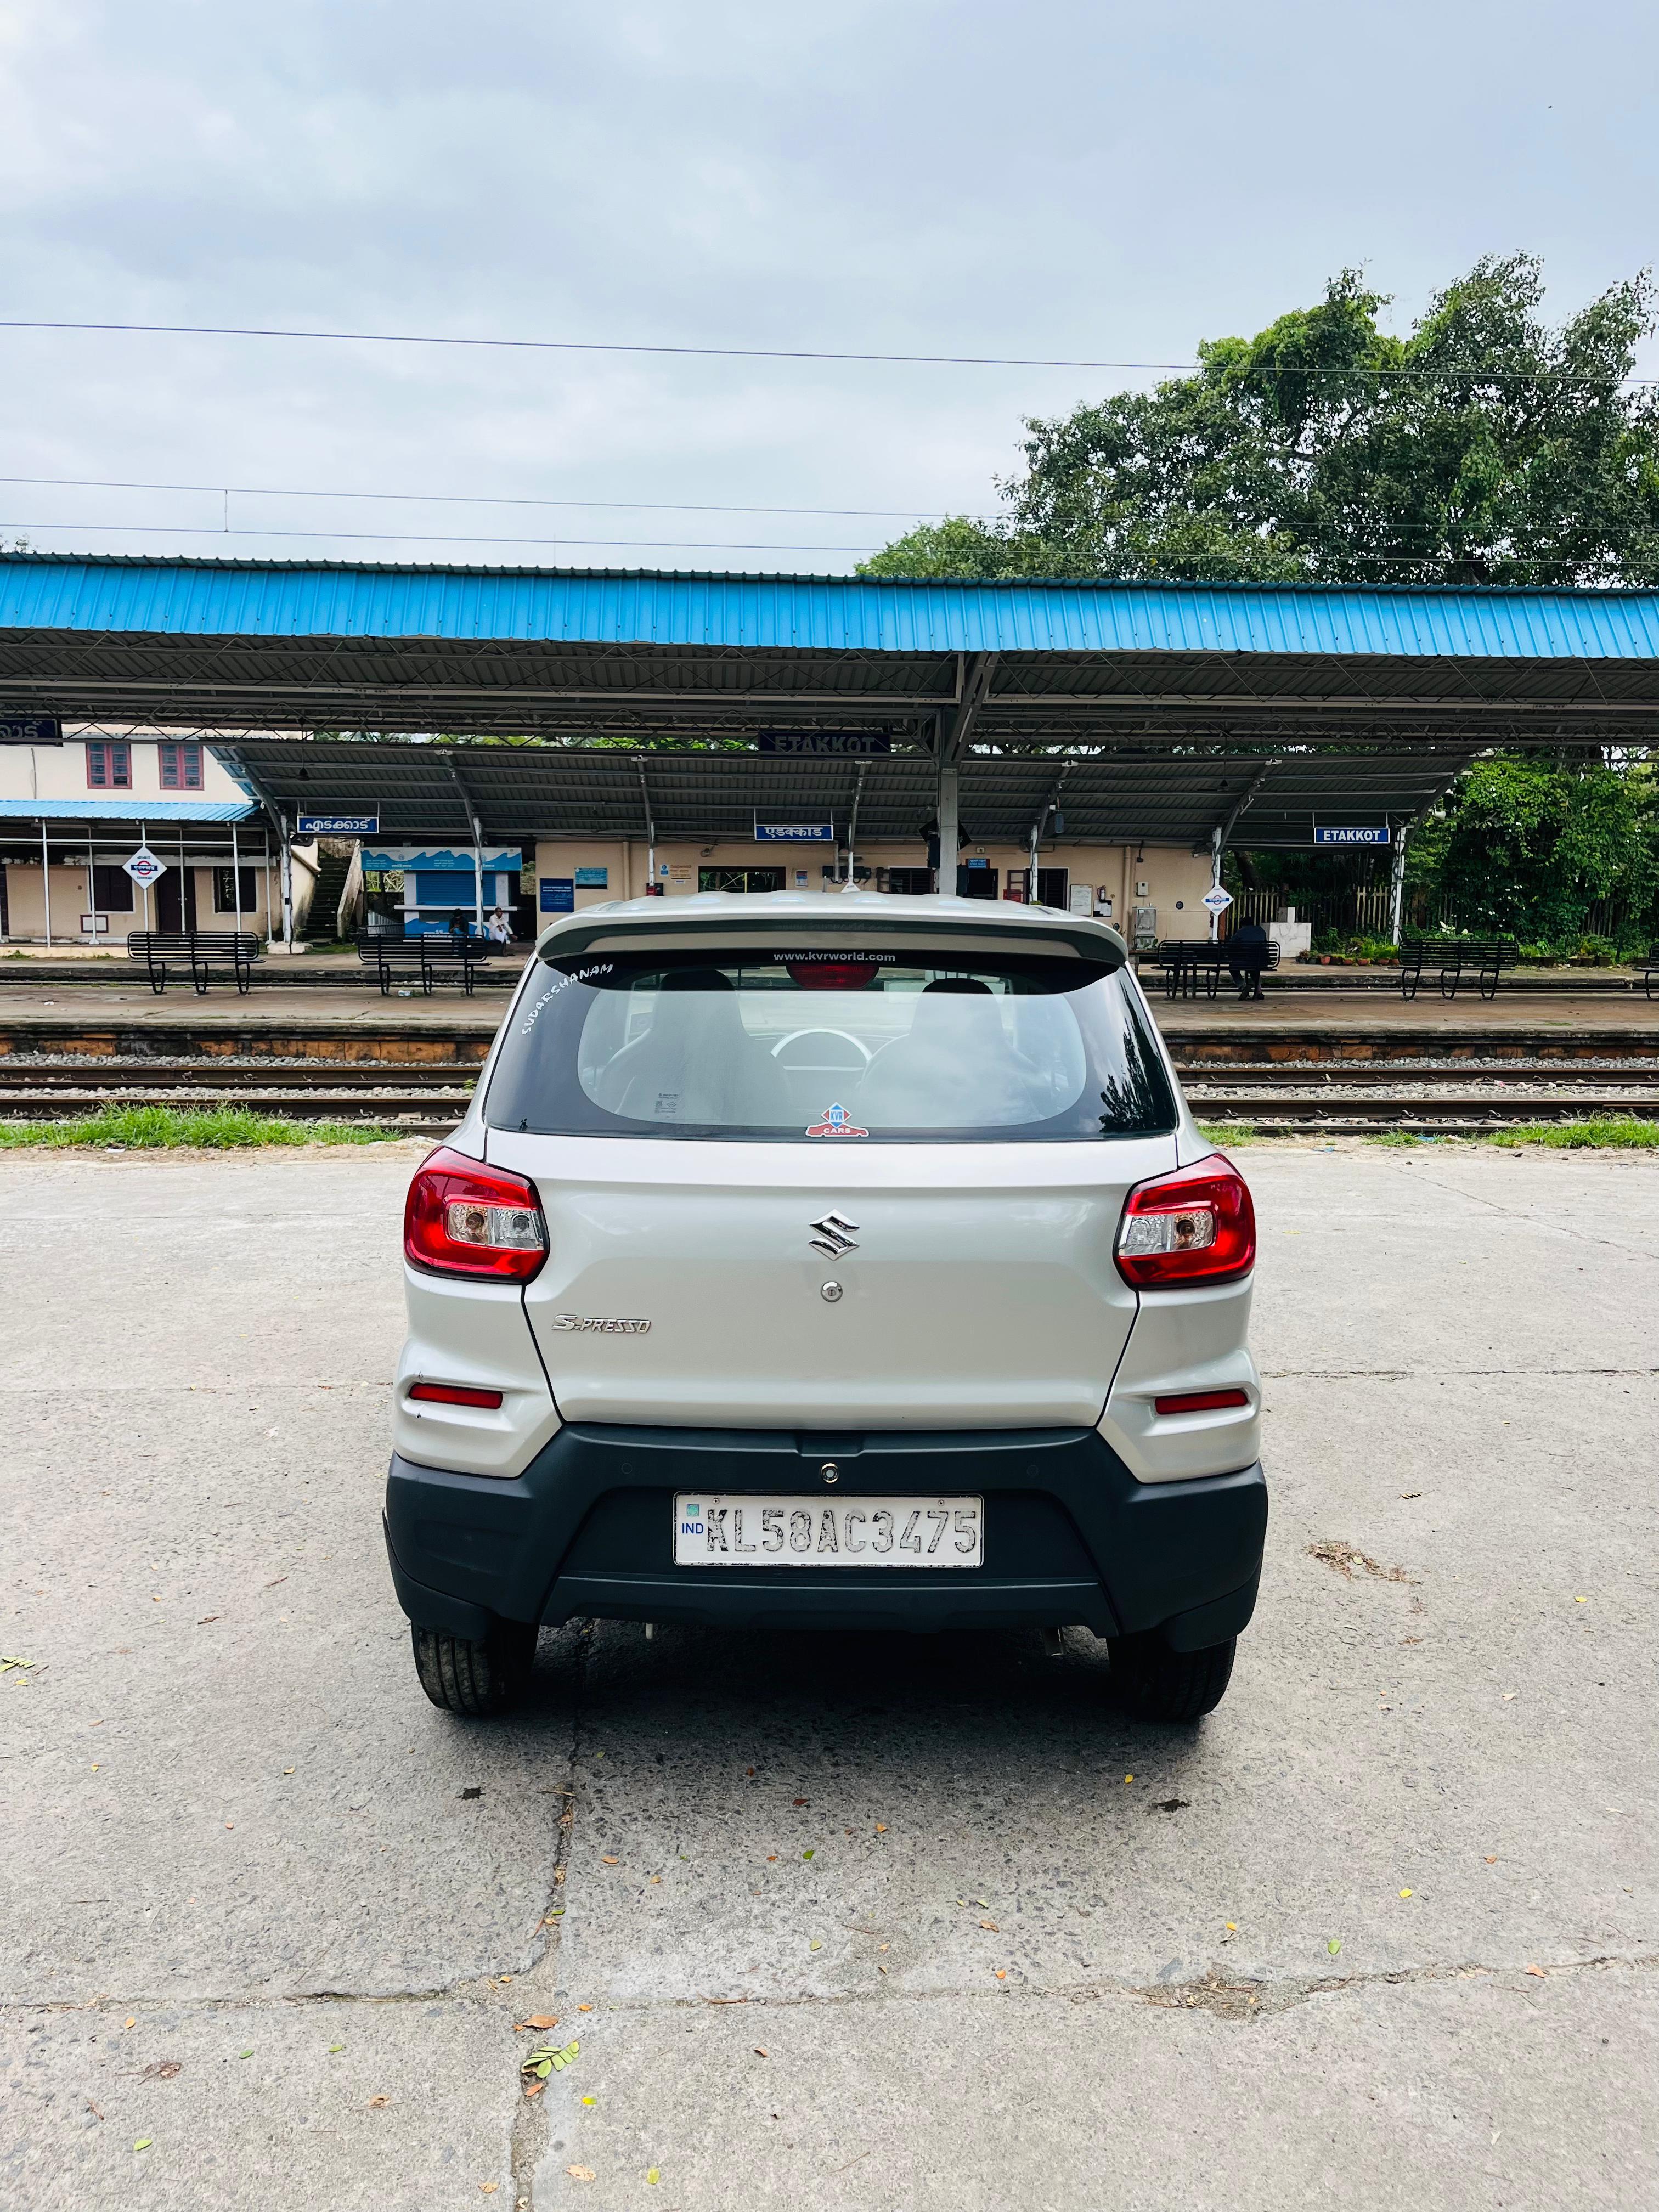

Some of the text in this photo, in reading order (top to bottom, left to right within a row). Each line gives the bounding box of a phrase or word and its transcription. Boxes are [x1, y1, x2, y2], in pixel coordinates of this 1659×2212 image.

[775, 736, 875, 753] ETAKKOT
[306, 818, 371, 832] എടക്കാട്
[764, 827, 823, 838] एडक्काड
[1323, 830, 1381, 841] ETAKKOT
[774, 952, 896, 962] www.kvrworld.com
[521, 964, 613, 1035] SUDARSHANAM
[830, 1111, 843, 1121] KVR
[551, 1314, 651, 1334] S-PRESSO
[682, 1523, 704, 1534] IND
[707, 1509, 976, 1553] KL58AC3475
